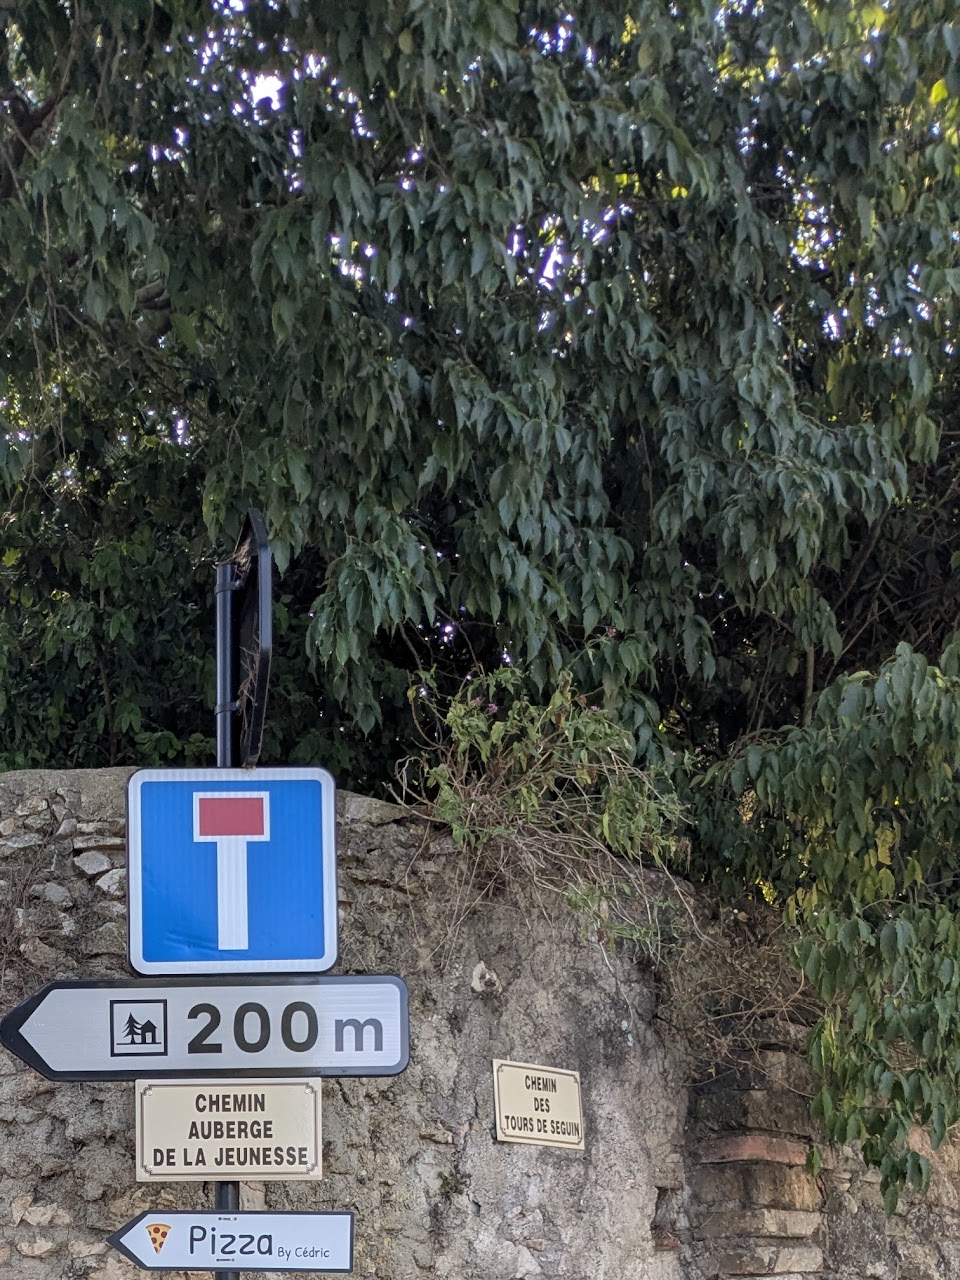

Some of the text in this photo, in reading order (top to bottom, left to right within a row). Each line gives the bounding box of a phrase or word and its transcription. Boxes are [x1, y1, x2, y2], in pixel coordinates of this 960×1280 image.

[187, 1001, 383, 1054] 200 m
[525, 1075, 557, 1093] CHEMIN
[195, 1093, 266, 1113] CHEMIN
[533, 1097, 550, 1113] DES
[188, 1120, 273, 1140] AUBERGE
[504, 1115, 580, 1137] TOURS DE SEGUIN
[153, 1146, 309, 1167] DE LA JEUNESSE
[189, 1225, 330, 1261] Pizza By Cédric
